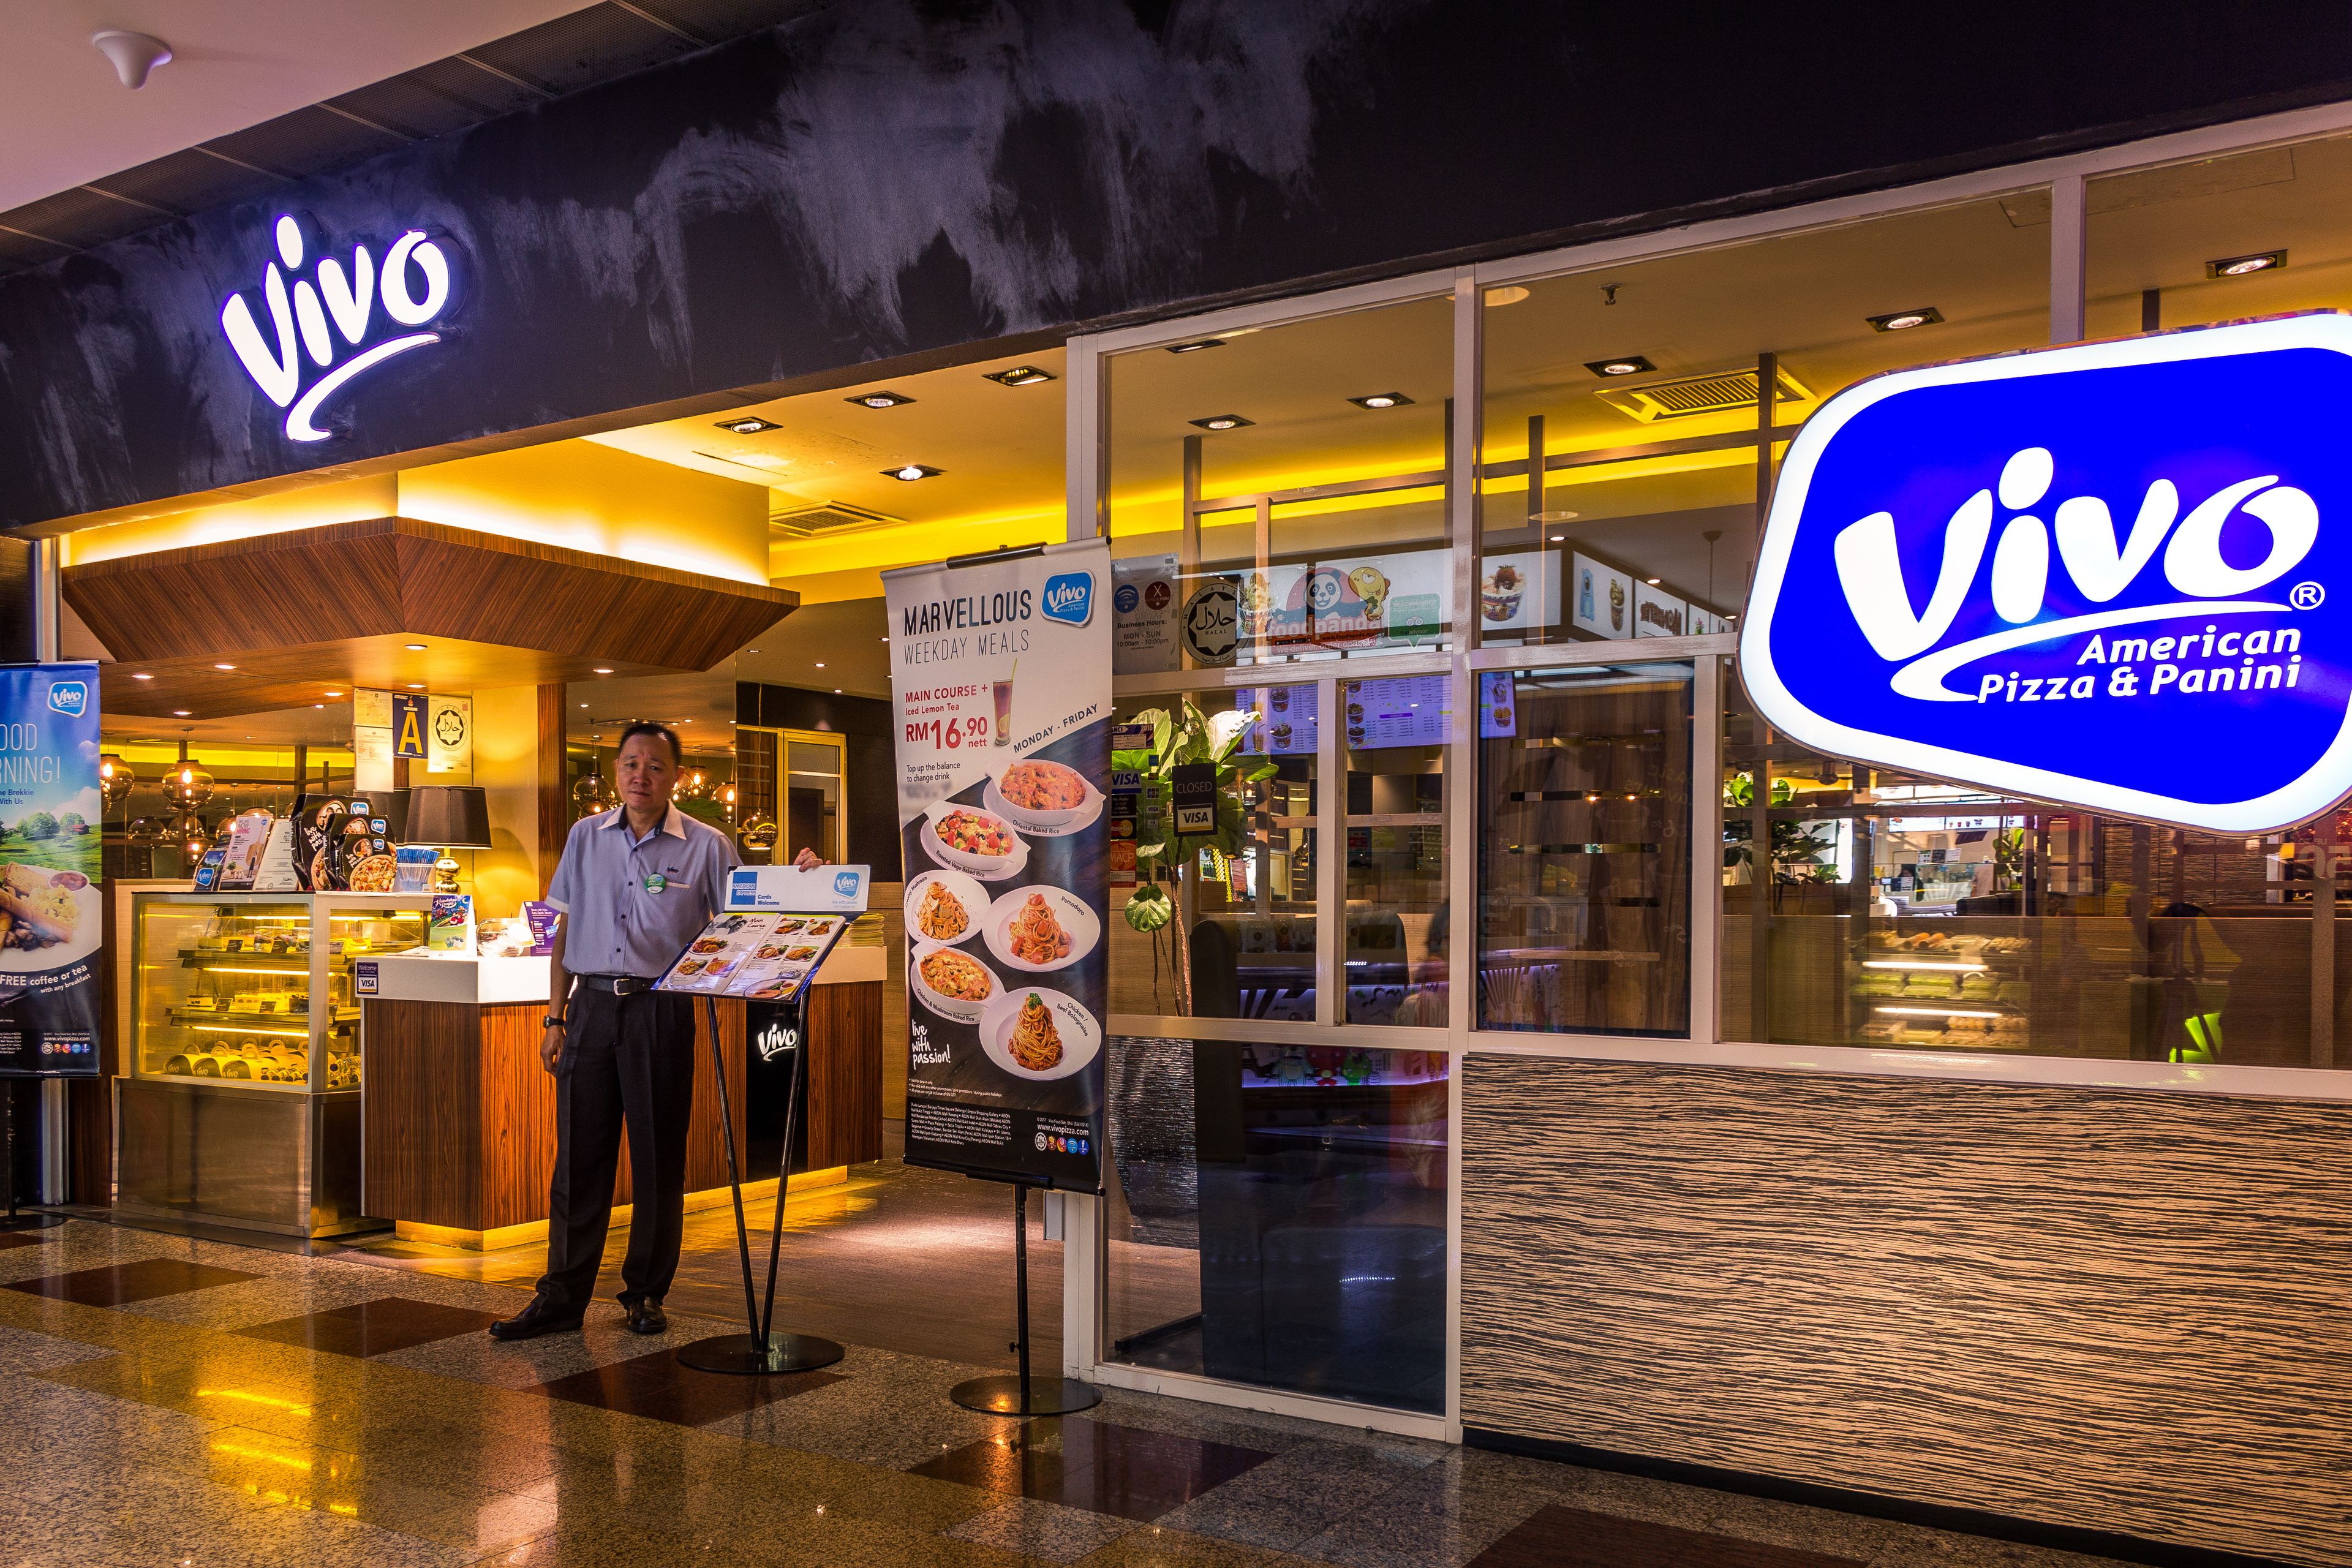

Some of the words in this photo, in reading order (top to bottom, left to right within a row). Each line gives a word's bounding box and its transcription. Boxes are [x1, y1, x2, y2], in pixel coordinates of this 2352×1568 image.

[1834, 447, 2320, 662] Vivo
[1047, 583, 1085, 608] Vivo
[904, 589, 1031, 636] MARVELLOUS
[1267, 615, 1382, 640] foodpanda
[904, 636, 968, 665] WEEKDAY
[978, 629, 1029, 656] MEALS
[2077, 626, 2302, 665] American
[1978, 674, 2094, 704] Pizza
[2108, 668, 2138, 697] &
[2150, 655, 2301, 695] Panini
[905, 690, 930, 703] MAIN
[934, 685, 977, 698] COURSE
[905, 706, 919, 715] Iced
[921, 704, 944, 715] Lemon
[947, 703, 959, 711] Tea
[398, 712, 423, 753] A
[1014, 725, 1054, 753] MONDAY
[1063, 704, 1099, 728] FRIDAY
[968, 738, 987, 747] nett
[0, 756, 60, 783] NING!
[907, 764, 916, 773] Top
[913, 774, 933, 783] change
[1112, 773, 1139, 785] VISA
[1177, 782, 1212, 794] CLOSED
[1012, 820, 1032, 832] Oriental
[1182, 812, 1208, 823] VISA
[304, 826, 317, 835] live
[936, 850, 951, 865] Roasted
[951, 861, 962, 871] Vege
[911, 876, 927, 891] Mushroom
[1061, 896, 1085, 916] Pomodoro
[0, 974, 26, 986] FREE
[30, 976, 58, 986] coffee
[72, 965, 88, 975] tea
[65, 973, 91, 988] breakfast
[918, 988, 929, 1004] Chicken
[933, 1004, 952, 1017] Mushroom
[1068, 1003, 1084, 1019] Chicken
[912, 1019, 927, 1036] live
[1057, 1003, 1068, 1012] Beef
[1068, 1010, 1088, 1036] Bolognaise
[912, 1037, 930, 1052] with
[913, 1044, 951, 1070] passion!
[1037, 1125, 1088, 1136] www.vivopizza.com
